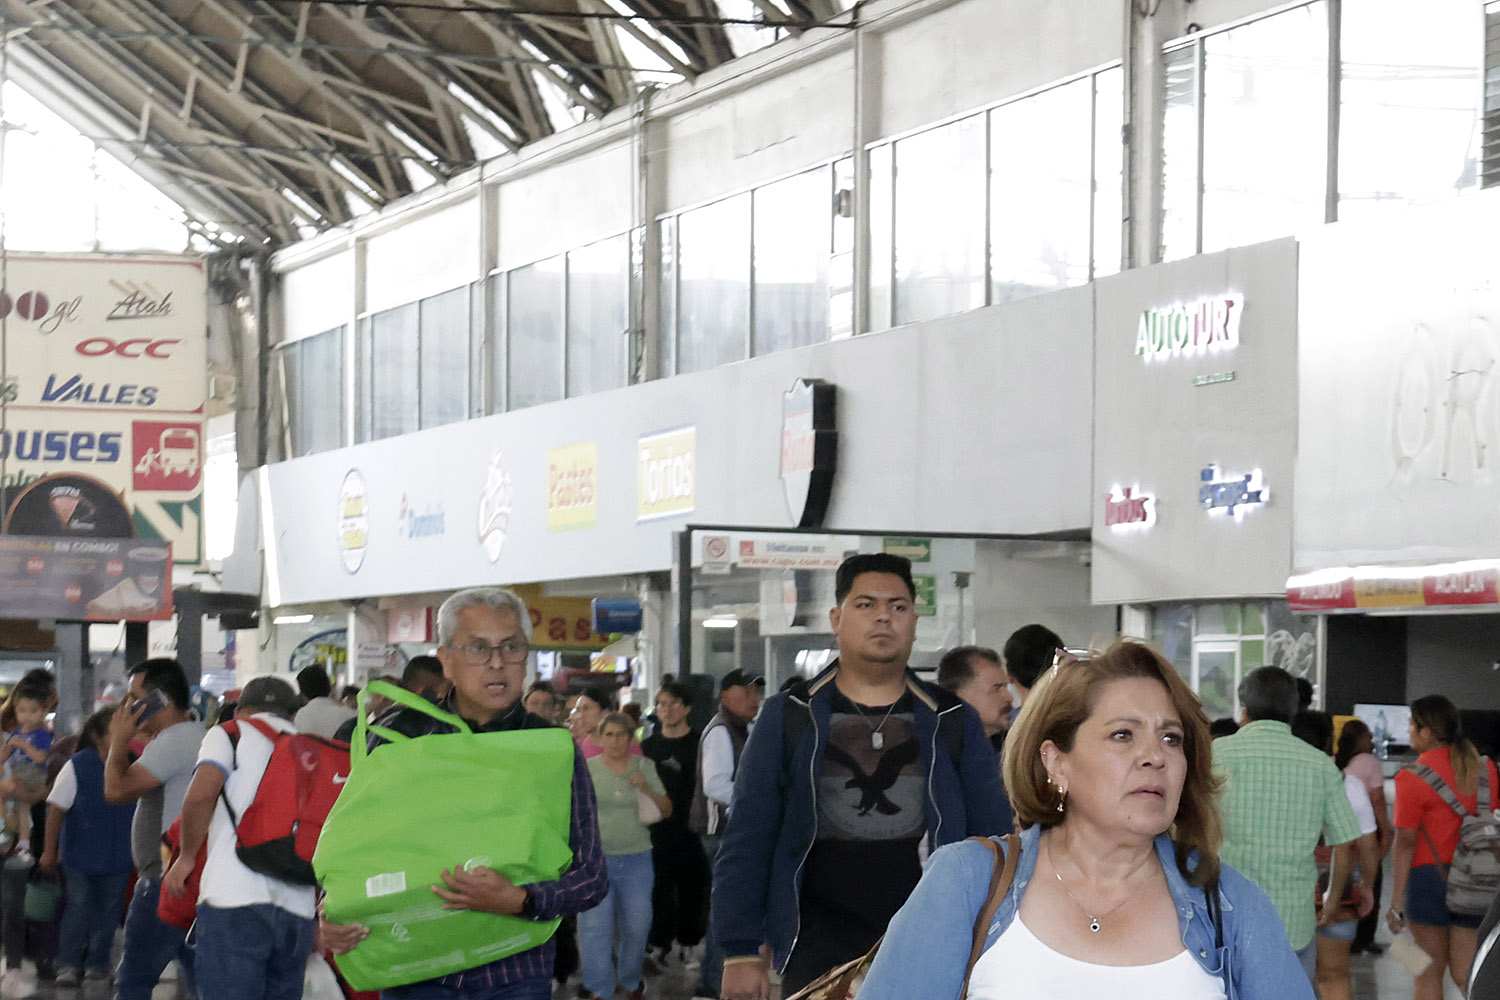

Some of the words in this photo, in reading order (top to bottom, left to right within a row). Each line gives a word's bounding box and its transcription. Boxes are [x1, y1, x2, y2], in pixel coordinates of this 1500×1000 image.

[75, 337, 182, 359] OCC
[40, 374, 158, 406] VALLES
[640, 445, 693, 506] Tortas
